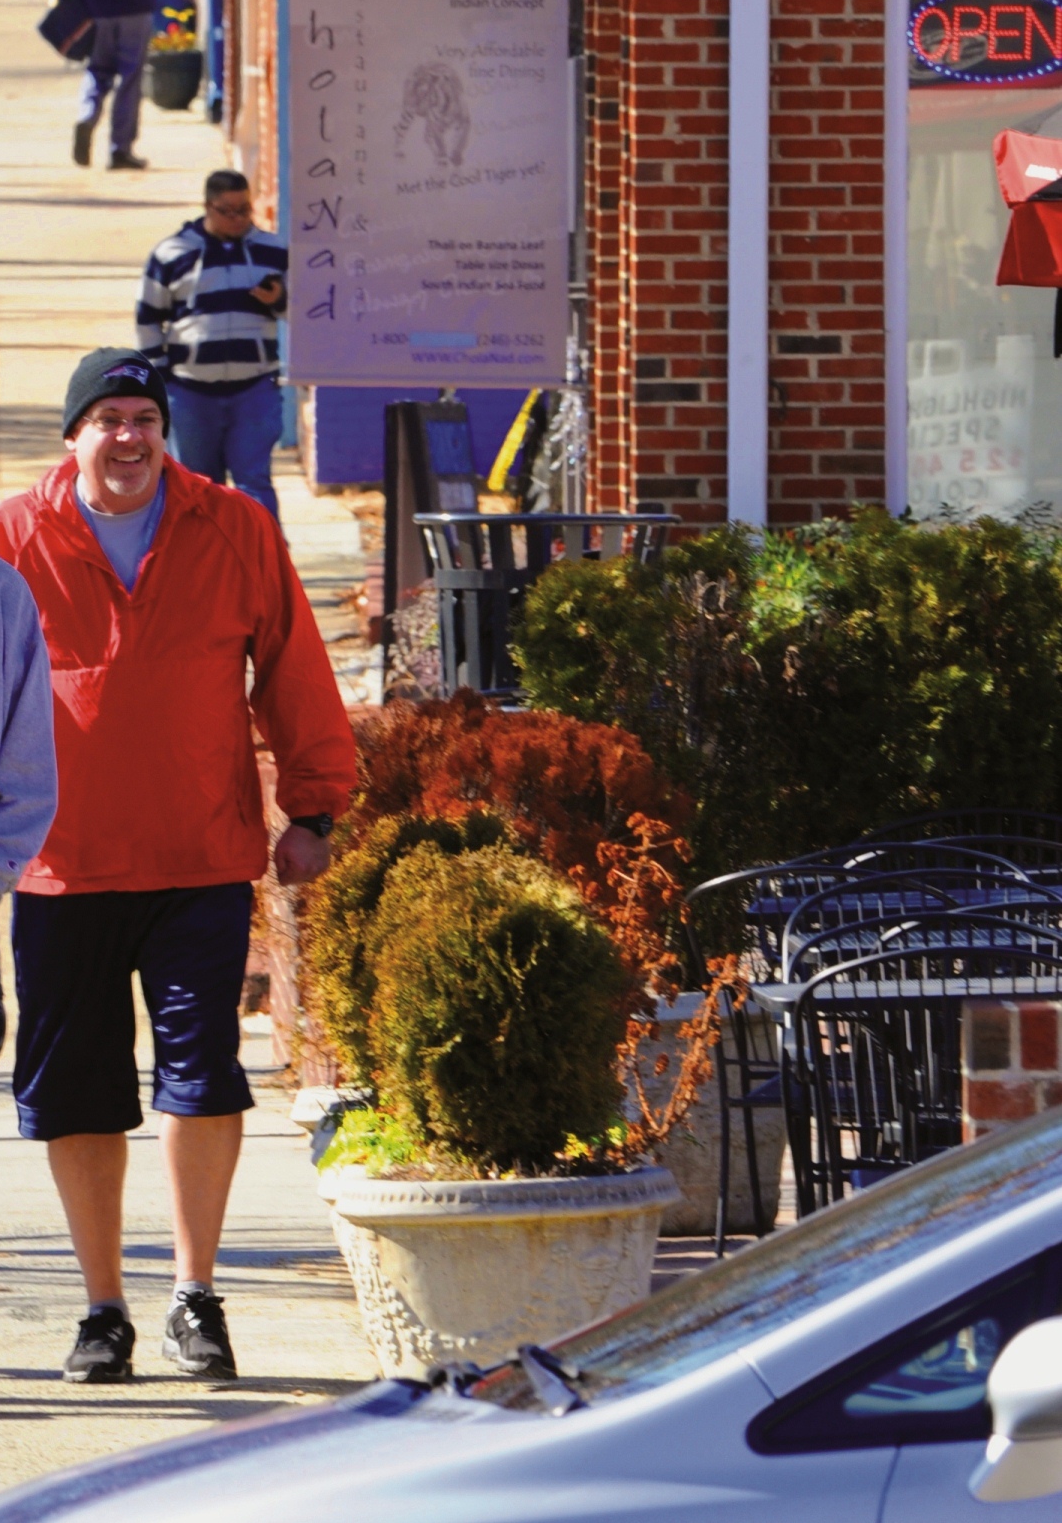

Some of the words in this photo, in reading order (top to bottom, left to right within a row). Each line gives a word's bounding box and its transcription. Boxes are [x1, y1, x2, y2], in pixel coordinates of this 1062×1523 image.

[913, 5, 1062, 62] OPEN
[436, 45, 465, 61] Very
[471, 41, 544, 57] Affordable
[499, 64, 545, 82] Dining
[396, 180, 421, 195] Met
[425, 177, 445, 191] the
[449, 169, 482, 188] Cool
[485, 168, 516, 185] Tiger
[459, 242, 473, 250] on
[476, 240, 517, 250] Banana
[521, 239, 545, 250] Leaf
[456, 260, 485, 271] Table
[488, 261, 509, 271] size
[511, 260, 545, 271] Dosas
[421, 279, 453, 290] South
[495, 280, 514, 290] Sea
[517, 279, 545, 290] Food
